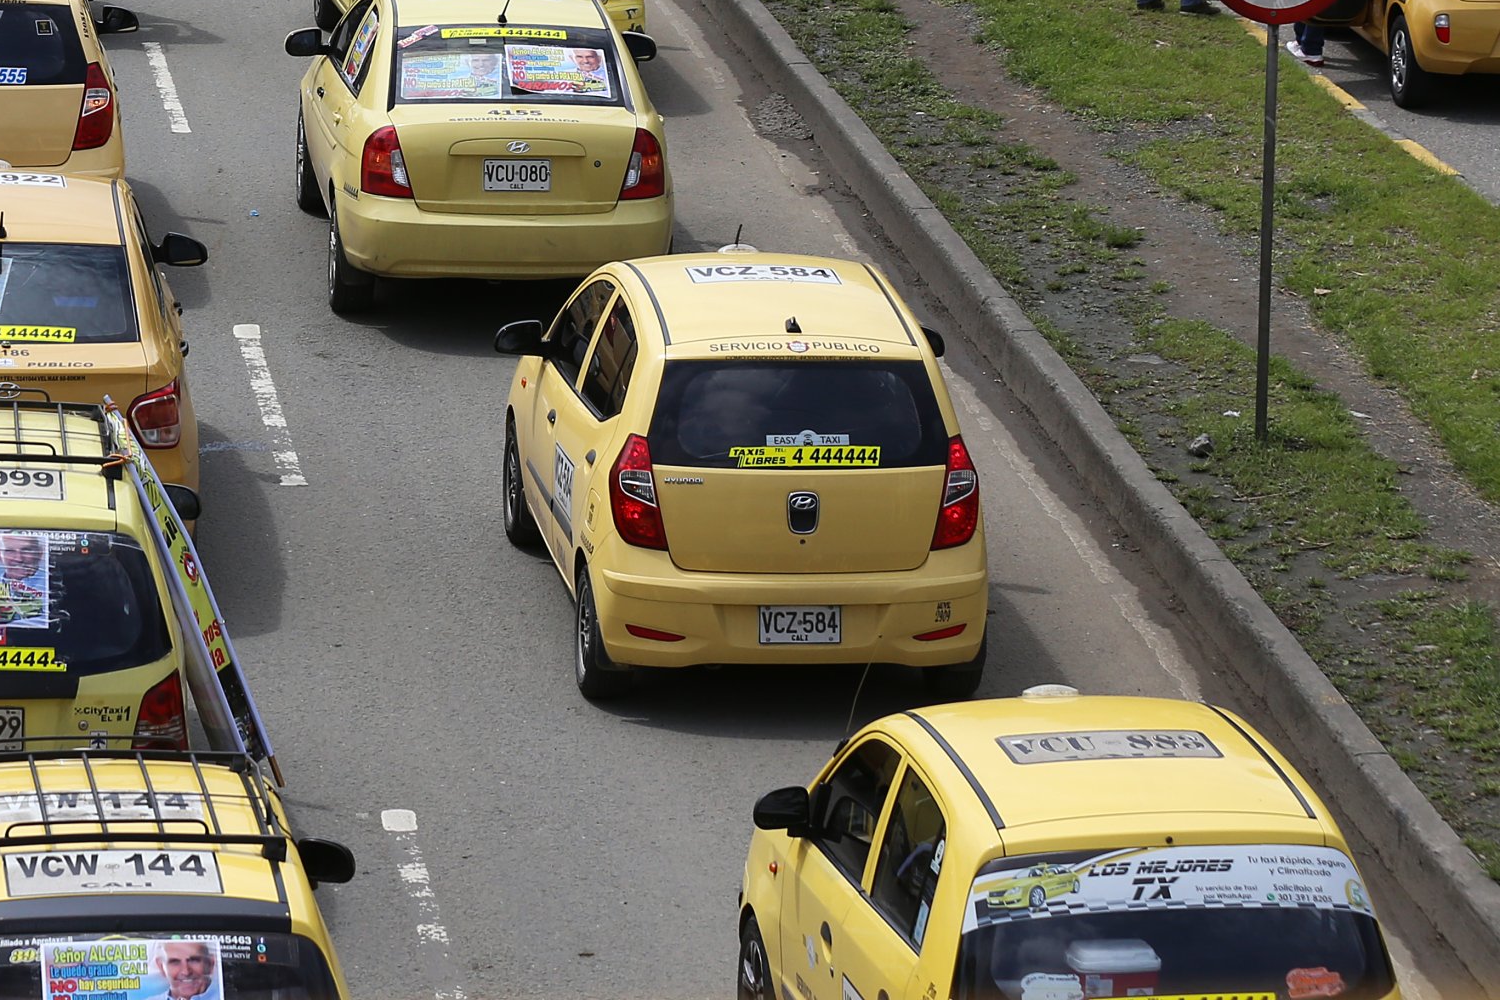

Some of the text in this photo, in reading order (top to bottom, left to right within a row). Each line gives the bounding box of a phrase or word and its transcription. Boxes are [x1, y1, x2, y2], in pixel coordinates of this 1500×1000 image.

[513, 71, 525, 81] NO
[6, 327, 73, 340] 444444
[709, 341, 881, 354] SERVICIO PUBLICO
[773, 436, 841, 445] EASY TAXI
[733, 448, 765, 457] TAXIS
[745, 448, 879, 466] LIBRES 4 444444
[1088, 858, 1235, 877] LOS MEJORES
[1247, 856, 1347, 869] Tu taxi Seguro
[1277, 866, 1332, 877] Climatizado
[1132, 875, 1180, 901] TX
[52, 944, 148, 964] Señor ALCALDE
[88, 962, 149, 978] grande CALI
[50, 976, 140, 993] NO seguridad
